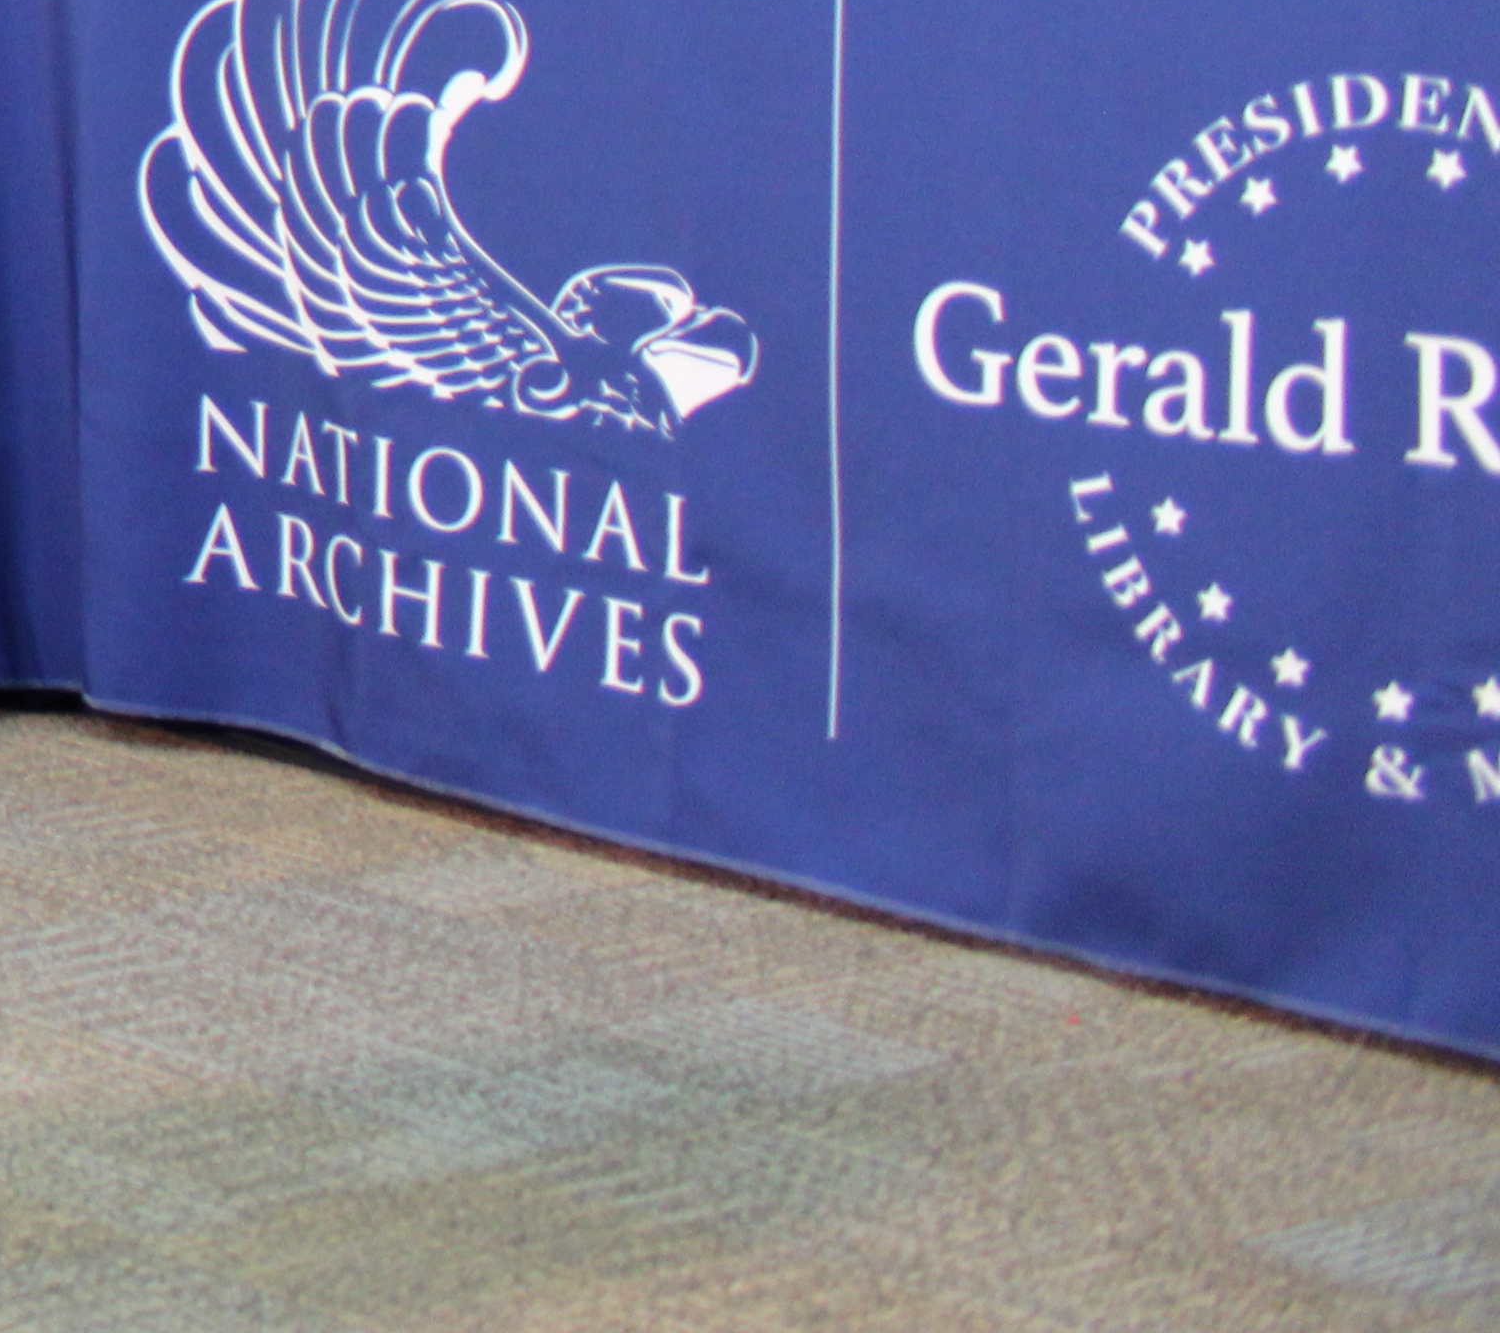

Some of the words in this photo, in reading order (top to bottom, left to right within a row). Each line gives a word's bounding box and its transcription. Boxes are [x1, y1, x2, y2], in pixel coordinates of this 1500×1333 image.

[914, 281, 1354, 454] Gerald
[1403, 331, 1500, 478] R
[194, 393, 712, 589] NATIONAL
[182, 501, 706, 710] ARCHIVES
[1067, 470, 1329, 776] LIBRARY
[1364, 741, 1427, 803] &
